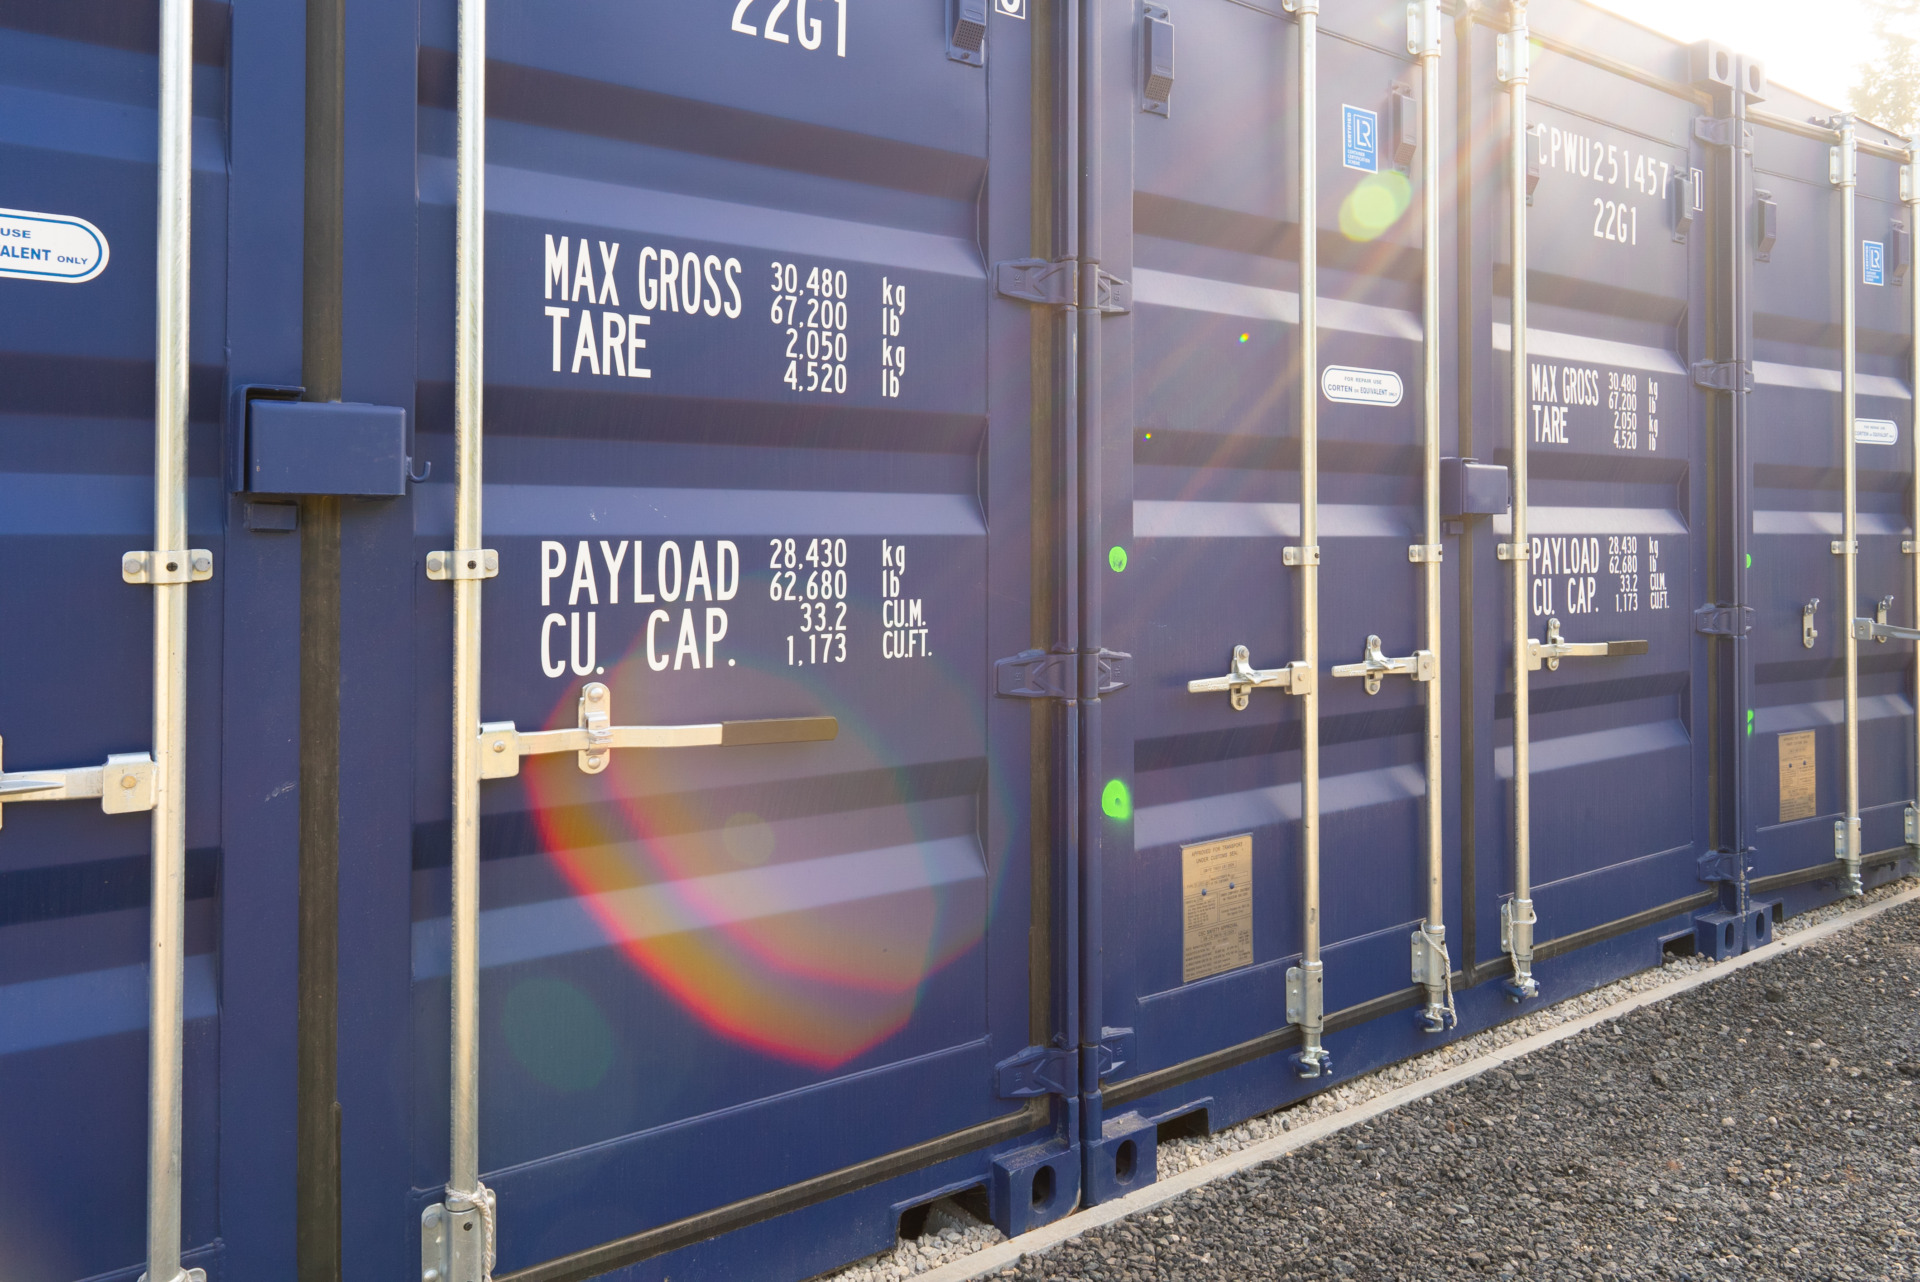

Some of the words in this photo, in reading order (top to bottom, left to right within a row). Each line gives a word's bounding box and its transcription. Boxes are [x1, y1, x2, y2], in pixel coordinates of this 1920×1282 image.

[0, 227, 32, 239] USE
[1593, 197, 1637, 246] 22G1
[57, 255, 88, 265] ONLY
[544, 233, 620, 307] MAX
[638, 246, 742, 319] GROSS
[770, 261, 848, 300] 30,480
[882, 276, 906, 316] kg
[770, 294, 848, 331] 67,200
[882, 306, 900, 337] lb
[544, 305, 652, 379] TARE
[785, 327, 848, 362] 2,050
[882, 337, 906, 377] kg
[783, 359, 848, 394] 4,520
[882, 368, 900, 398] lb
[1327, 383, 1353, 393] CORTEN
[1531, 363, 1558, 403] MAX
[1562, 366, 1600, 407] GROSS
[1648, 377, 1659, 401] kg
[1532, 404, 1569, 444] TARE
[1648, 414, 1659, 438] kg
[1648, 395, 1657, 414] lb
[1648, 433, 1657, 452] lb
[541, 540, 740, 606] PAYLOAD
[769, 538, 847, 570] 28,430
[882, 538, 906, 576] kg
[1532, 537, 1600, 576] PAYLOAD
[1648, 535, 1659, 559] kg
[1649, 555, 1657, 573] lb
[769, 570, 847, 602] 62,680
[882, 569, 900, 598] lb
[1533, 577, 1555, 616] CU.
[1567, 576, 1599, 614] CAP.
[1619, 573, 1638, 593] 33.2
[540, 611, 605, 678] CU.
[646, 607, 736, 672] CAP.
[799, 601, 847, 633] 33.2
[882, 598, 927, 629] CU.M.
[786, 632, 847, 667] 1,173
[882, 628, 933, 660] CU.FT.
